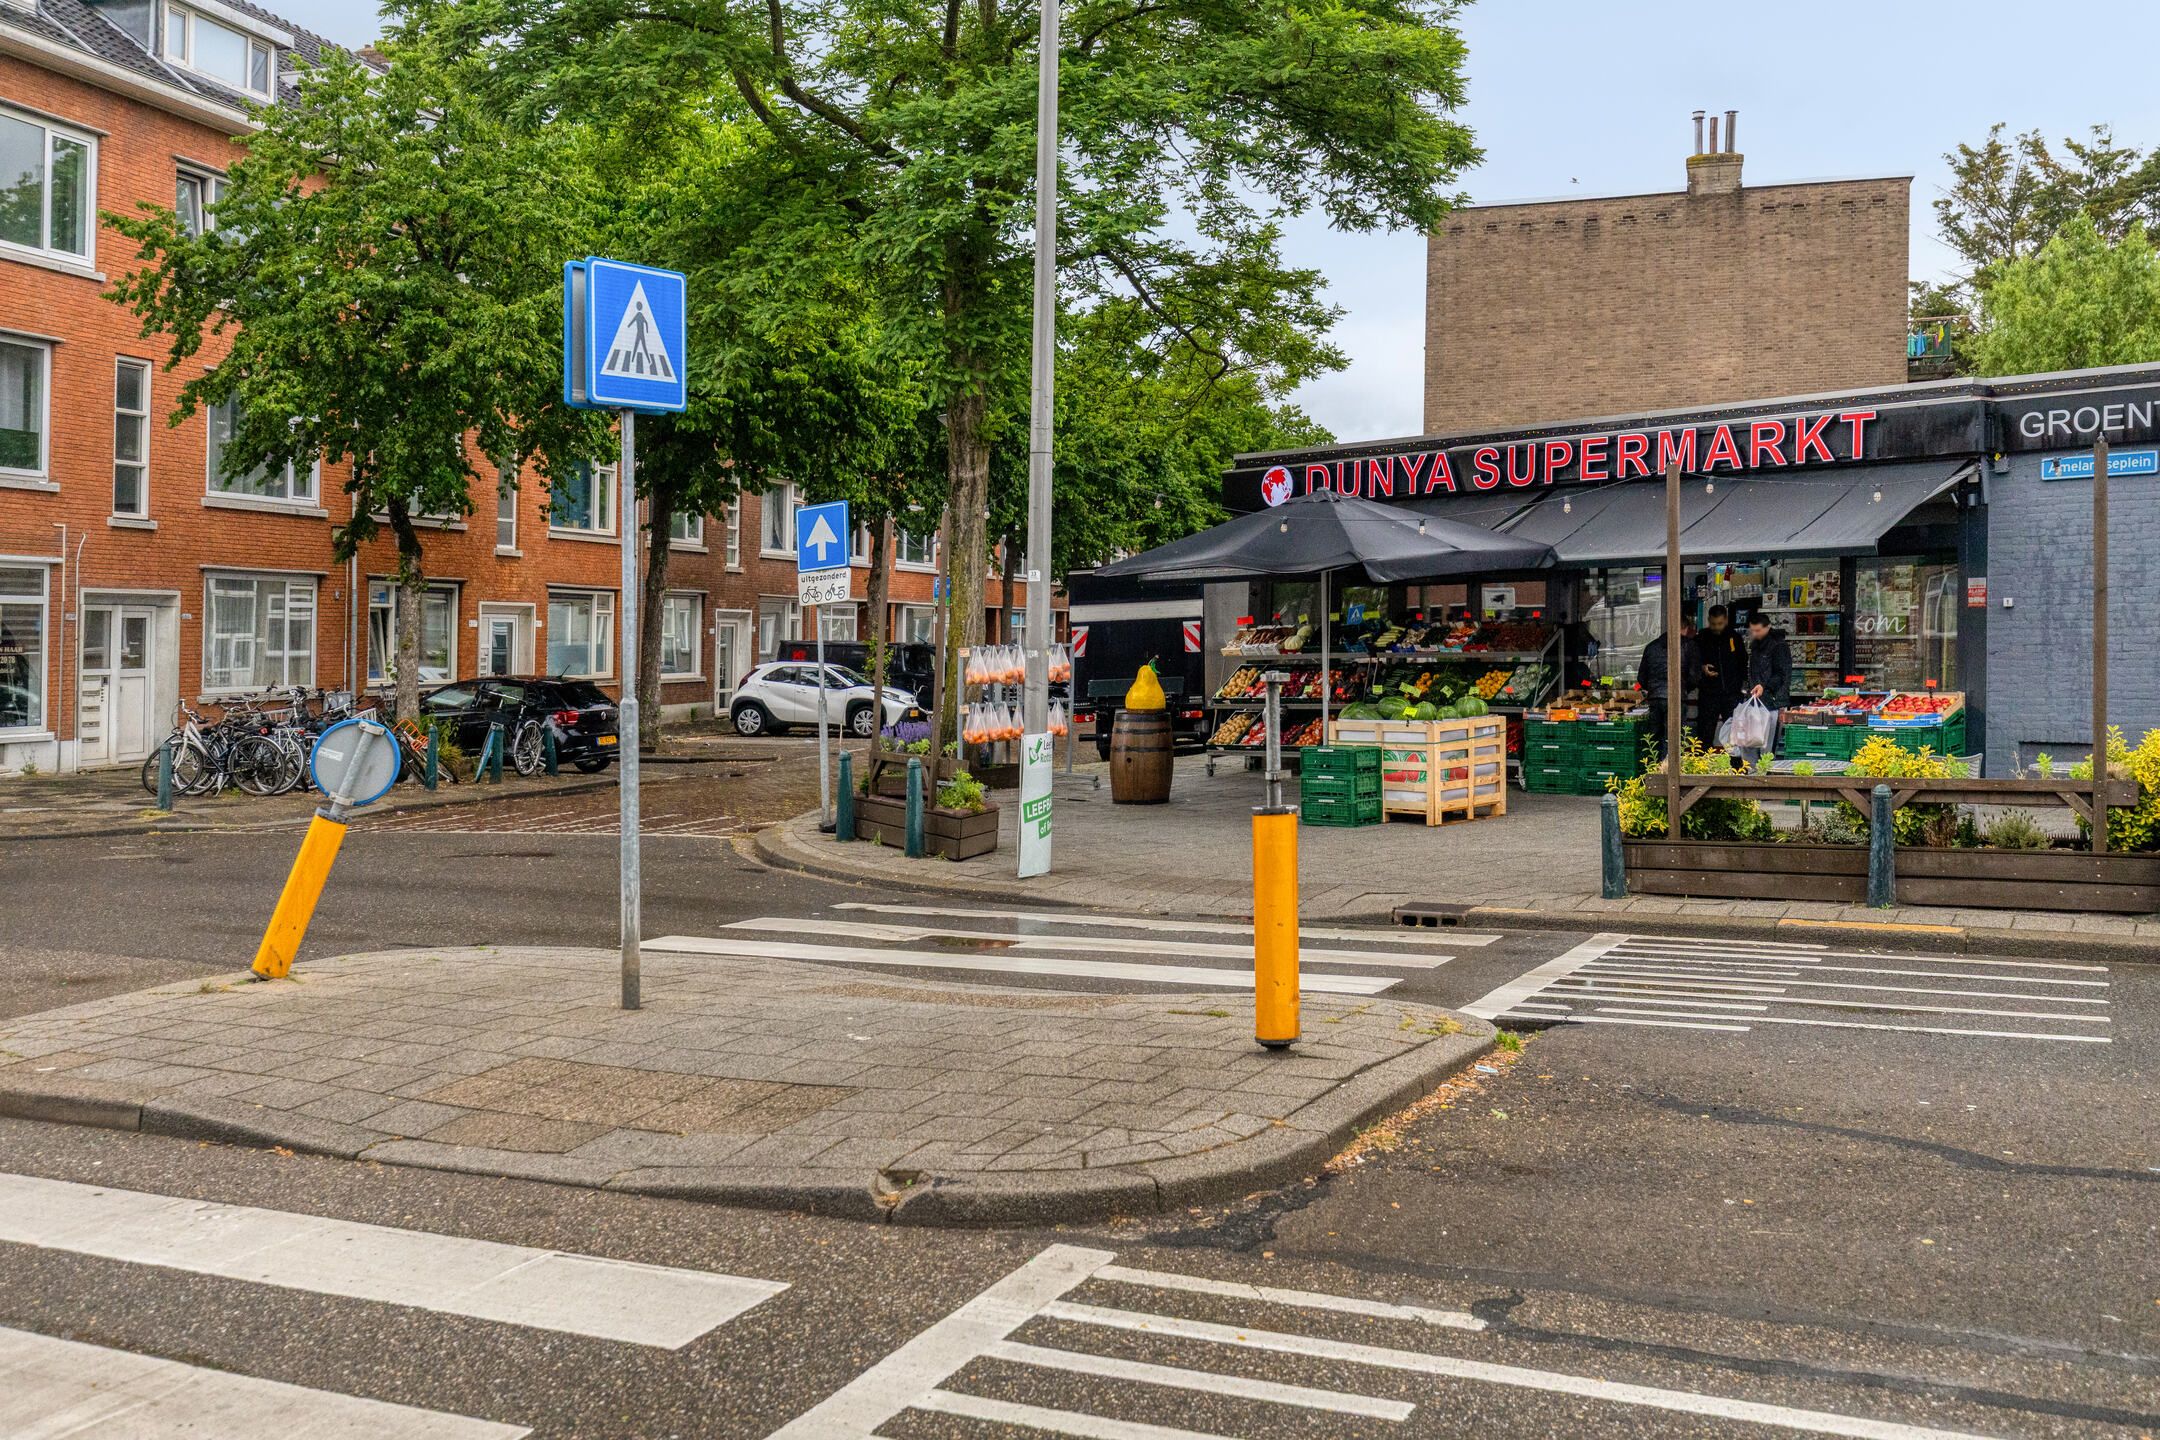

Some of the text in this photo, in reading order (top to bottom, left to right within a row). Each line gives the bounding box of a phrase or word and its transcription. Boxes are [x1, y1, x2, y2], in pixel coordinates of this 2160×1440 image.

[1305, 410, 1876, 498] DUNYA SUPERMARKT
[801, 572, 846, 583] uitgezonderd
